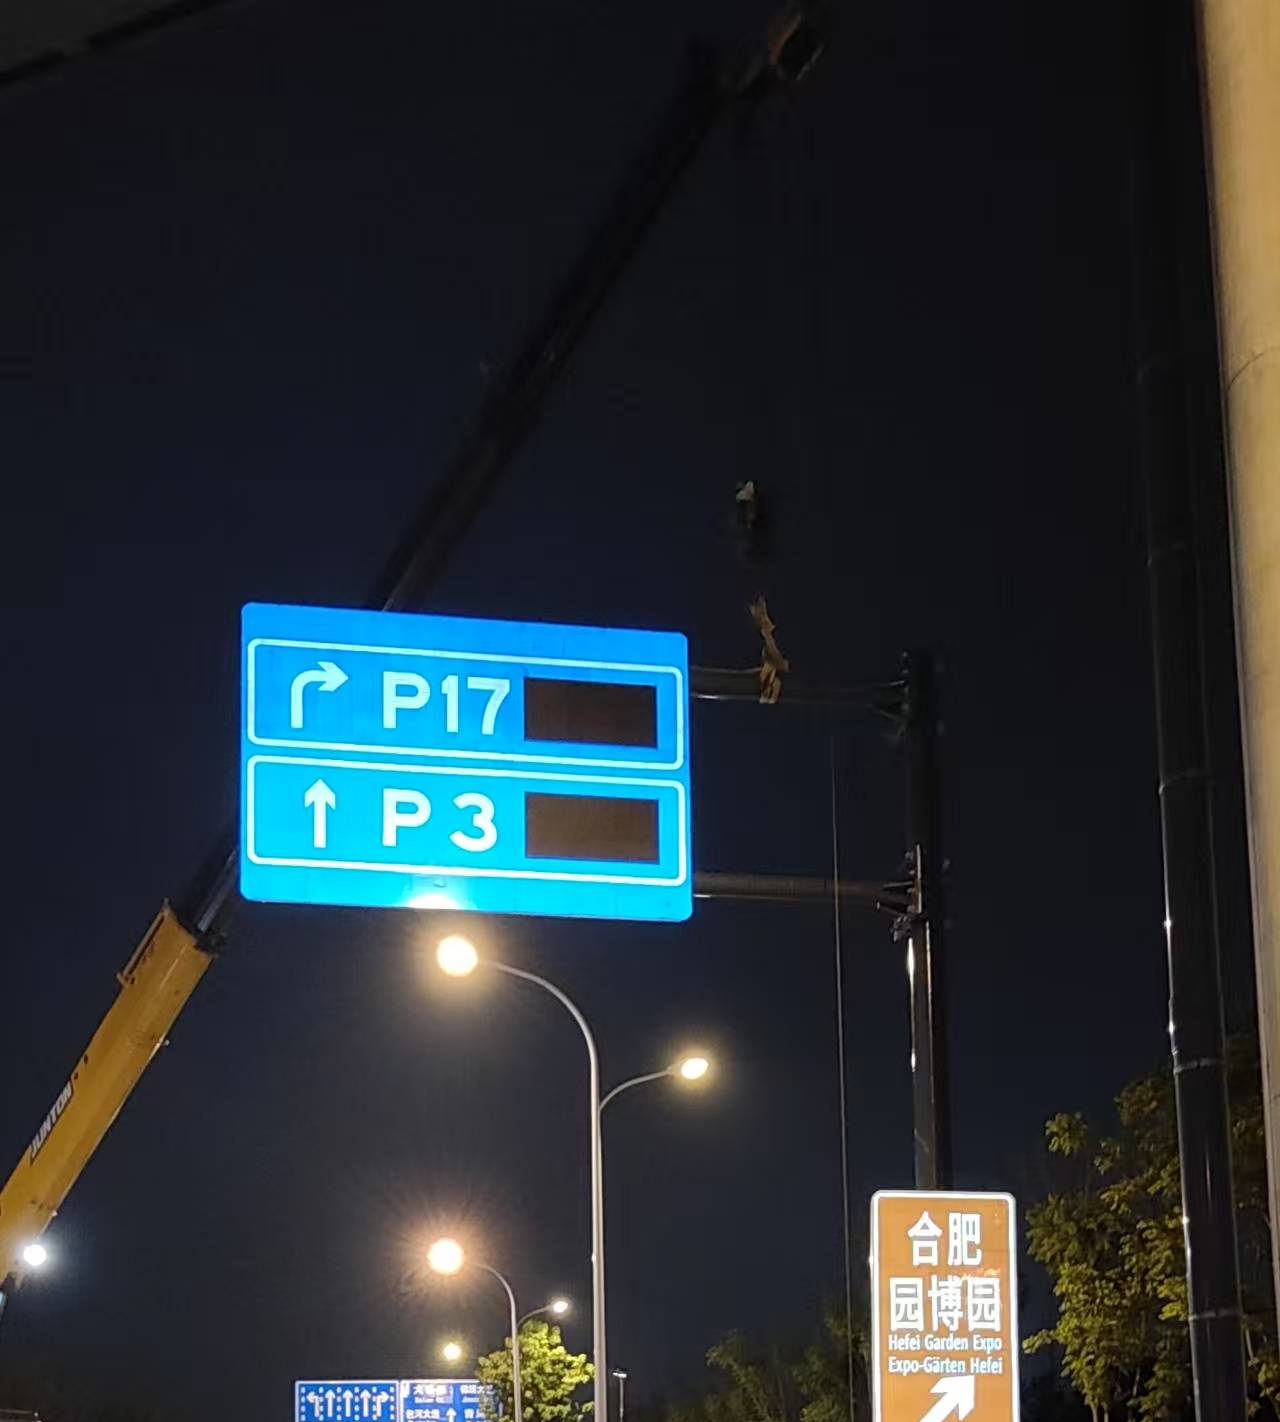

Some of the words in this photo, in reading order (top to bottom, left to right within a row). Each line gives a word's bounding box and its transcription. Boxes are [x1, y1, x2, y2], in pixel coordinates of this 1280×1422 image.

[382, 671, 511, 736] P17
[382, 788, 432, 847] P
[449, 792, 498, 852] 3
[907, 1210, 983, 1267] 合肥
[889, 1274, 1001, 1333] 园博园
[888, 1333, 920, 1351] Hefei
[924, 1333, 969, 1351] Garden
[973, 1334, 1003, 1355] Expo
[888, 1356, 966, 1377] Expo-Gärten
[970, 1356, 1003, 1374] Hefei
